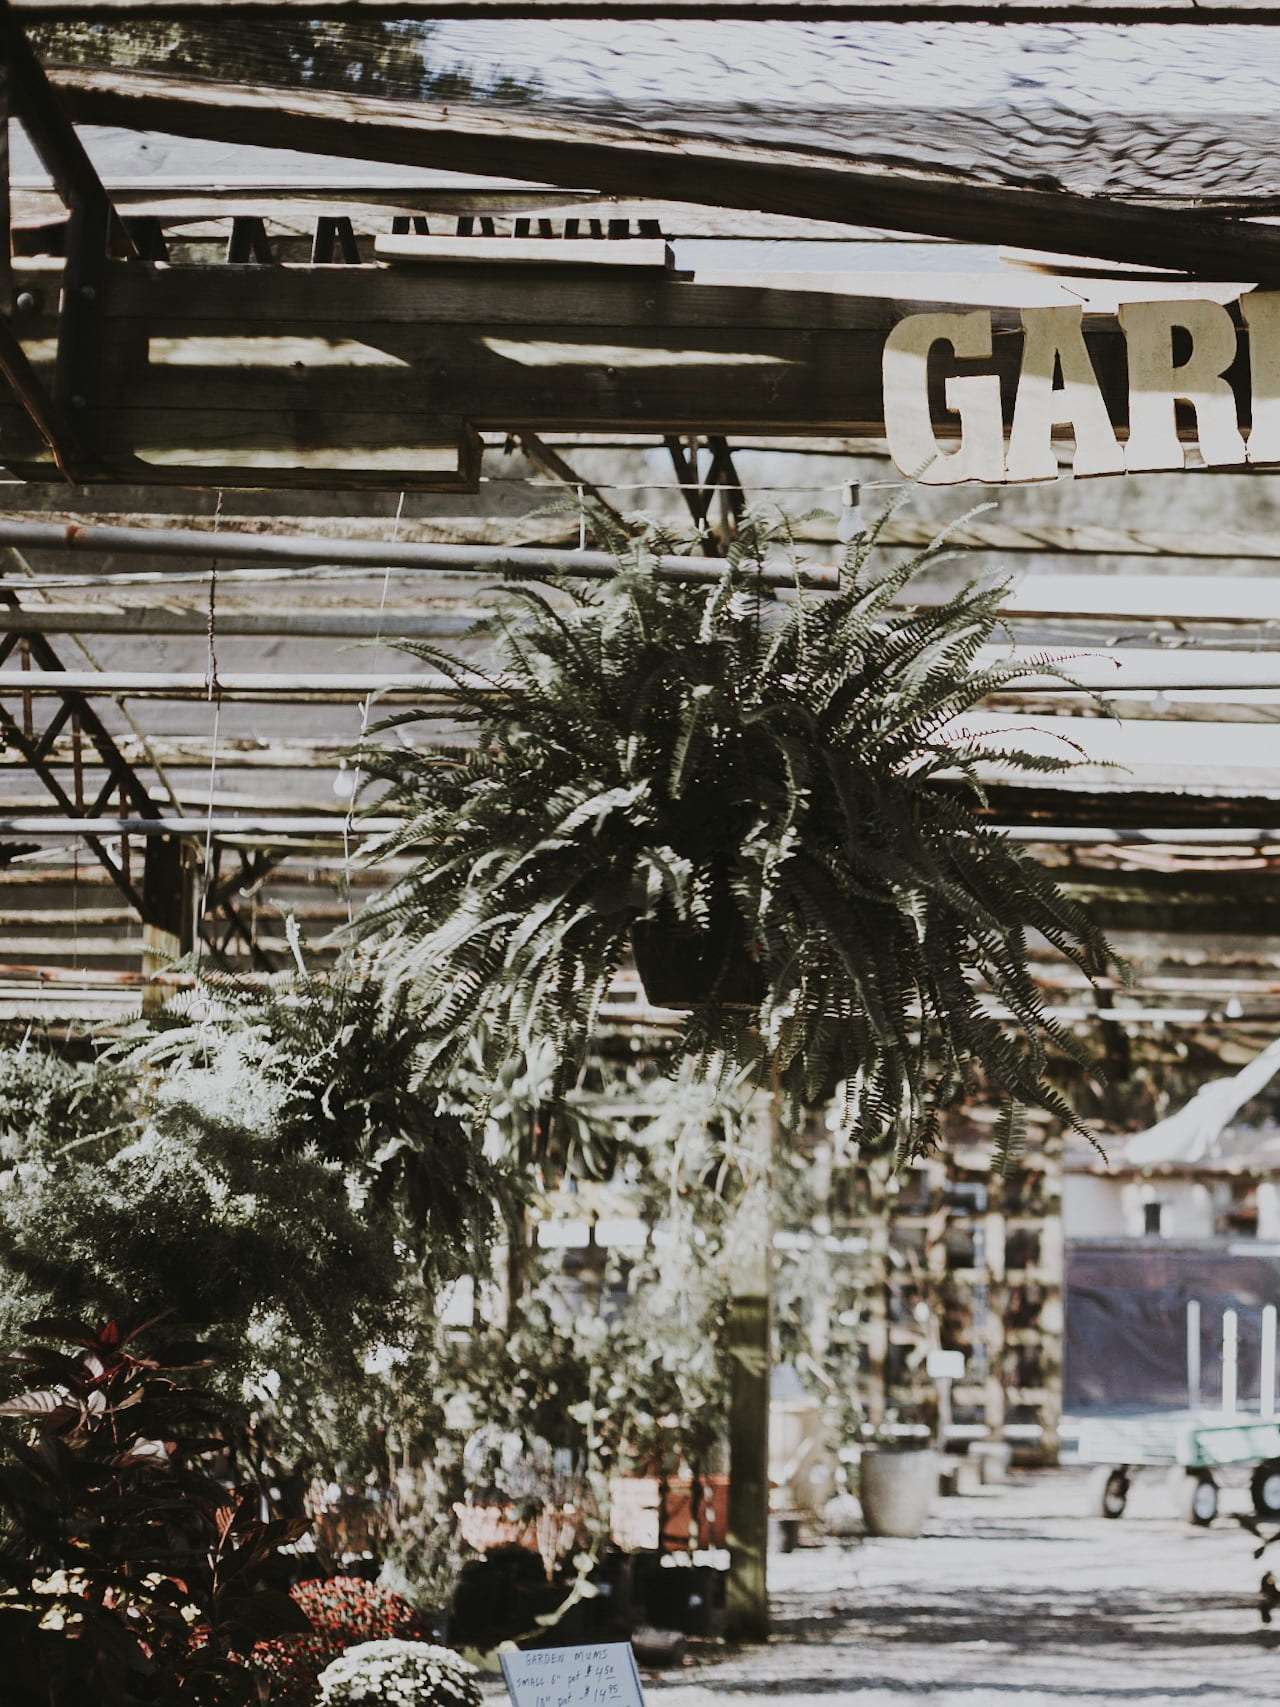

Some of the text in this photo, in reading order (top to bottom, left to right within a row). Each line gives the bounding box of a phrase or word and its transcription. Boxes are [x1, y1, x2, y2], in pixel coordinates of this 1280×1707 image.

[527, 1649, 608, 1666] GARDEN MUMS
[517, 1675, 545, 1688] SMALL
